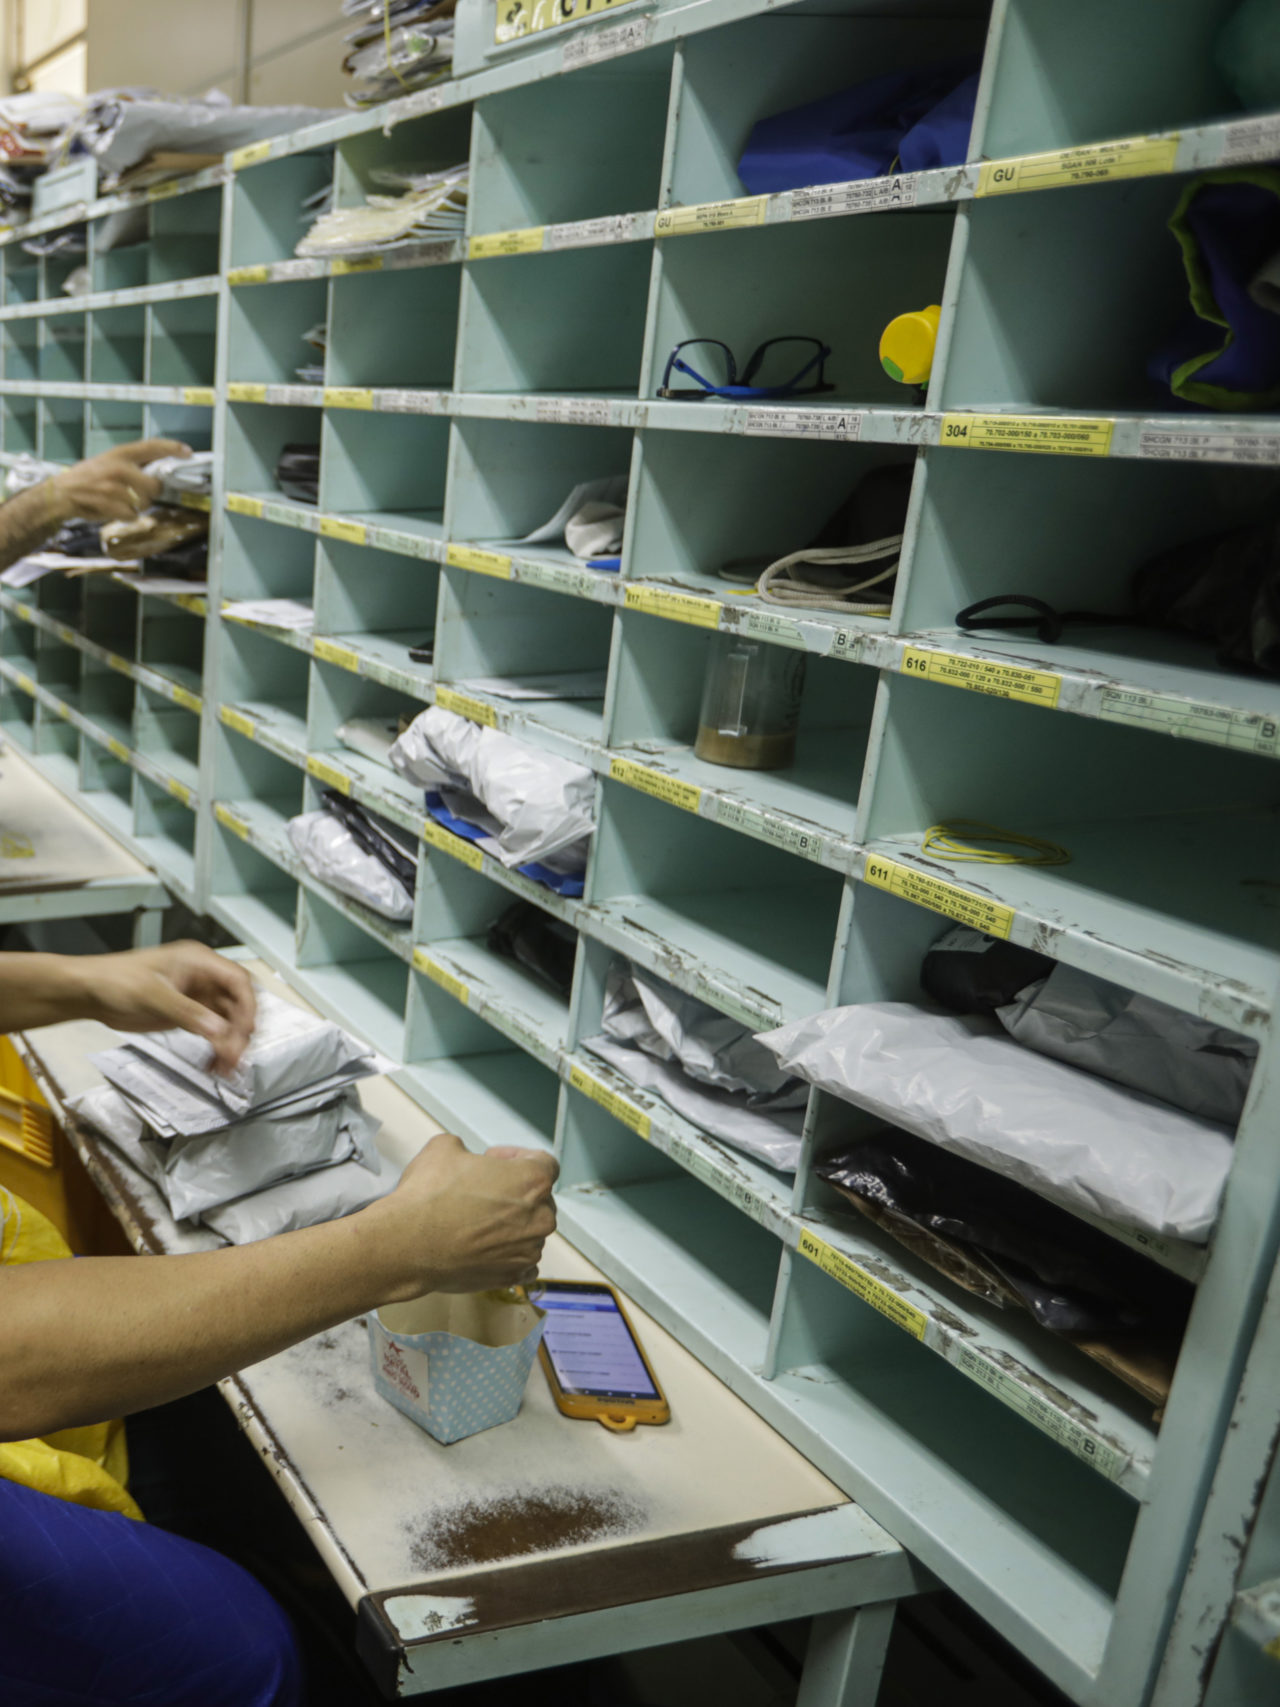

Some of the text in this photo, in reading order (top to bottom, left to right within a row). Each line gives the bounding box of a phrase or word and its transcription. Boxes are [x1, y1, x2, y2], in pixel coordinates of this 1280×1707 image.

[992, 167, 1015, 183] GU
[892, 178, 900, 191] A
[657, 216, 671, 228] GU
[837, 417, 847, 429] A
[945, 425, 968, 437] 304
[837, 632, 846, 646] B
[906, 657, 926, 672] 616
[1261, 721, 1275, 739] B
[800, 835, 808, 849] B
[870, 864, 888, 881] 611
[744, 1191, 753, 1206] B
[802, 1238, 819, 1258] 601
[1082, 1437, 1096, 1457] B
